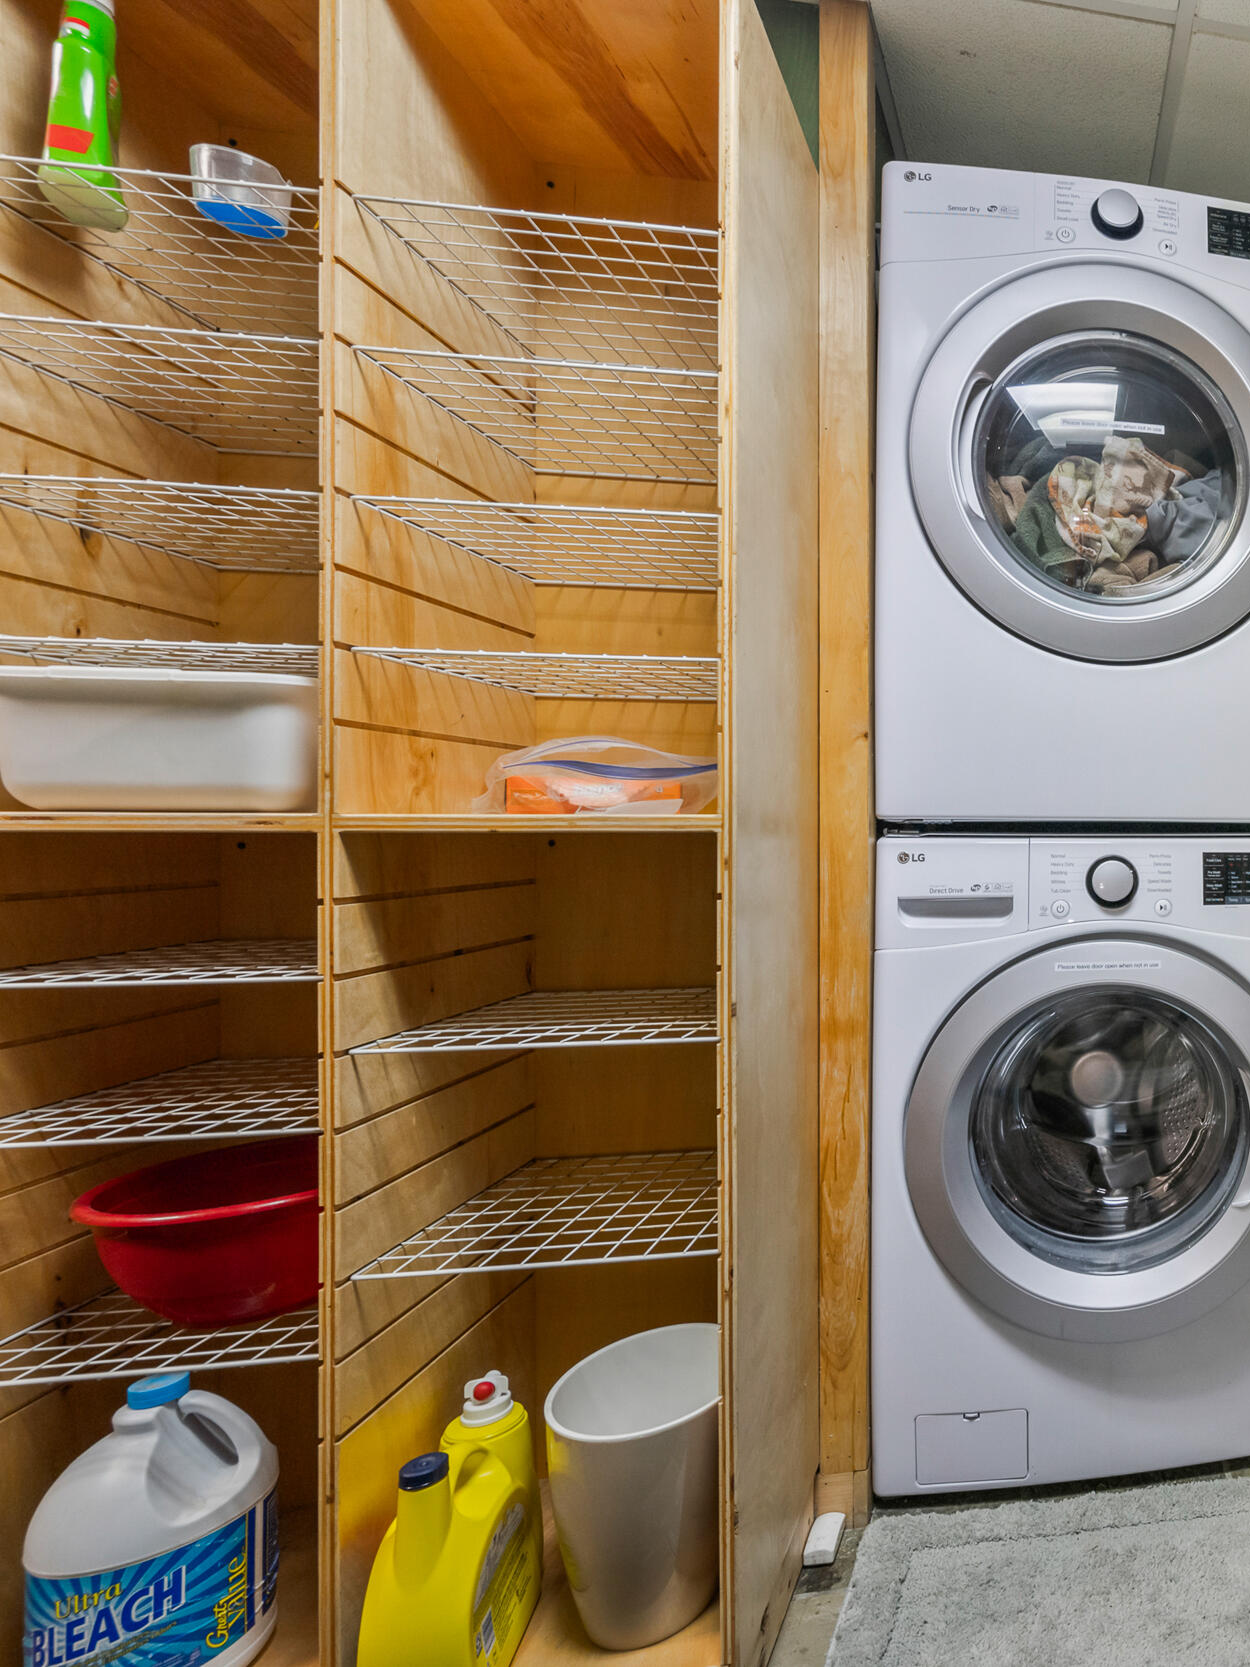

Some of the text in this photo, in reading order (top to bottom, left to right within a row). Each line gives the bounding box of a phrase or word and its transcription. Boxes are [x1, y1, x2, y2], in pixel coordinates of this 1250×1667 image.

[917, 173, 932, 182] LG
[947, 204, 980, 214] Sensor Dry
[911, 853, 926, 862] LG
[55, 1581, 122, 1620] Ultra
[218, 1551, 246, 1630] Value
[31, 1565, 187, 1667] BLEACH
[205, 1601, 229, 1649] Great
